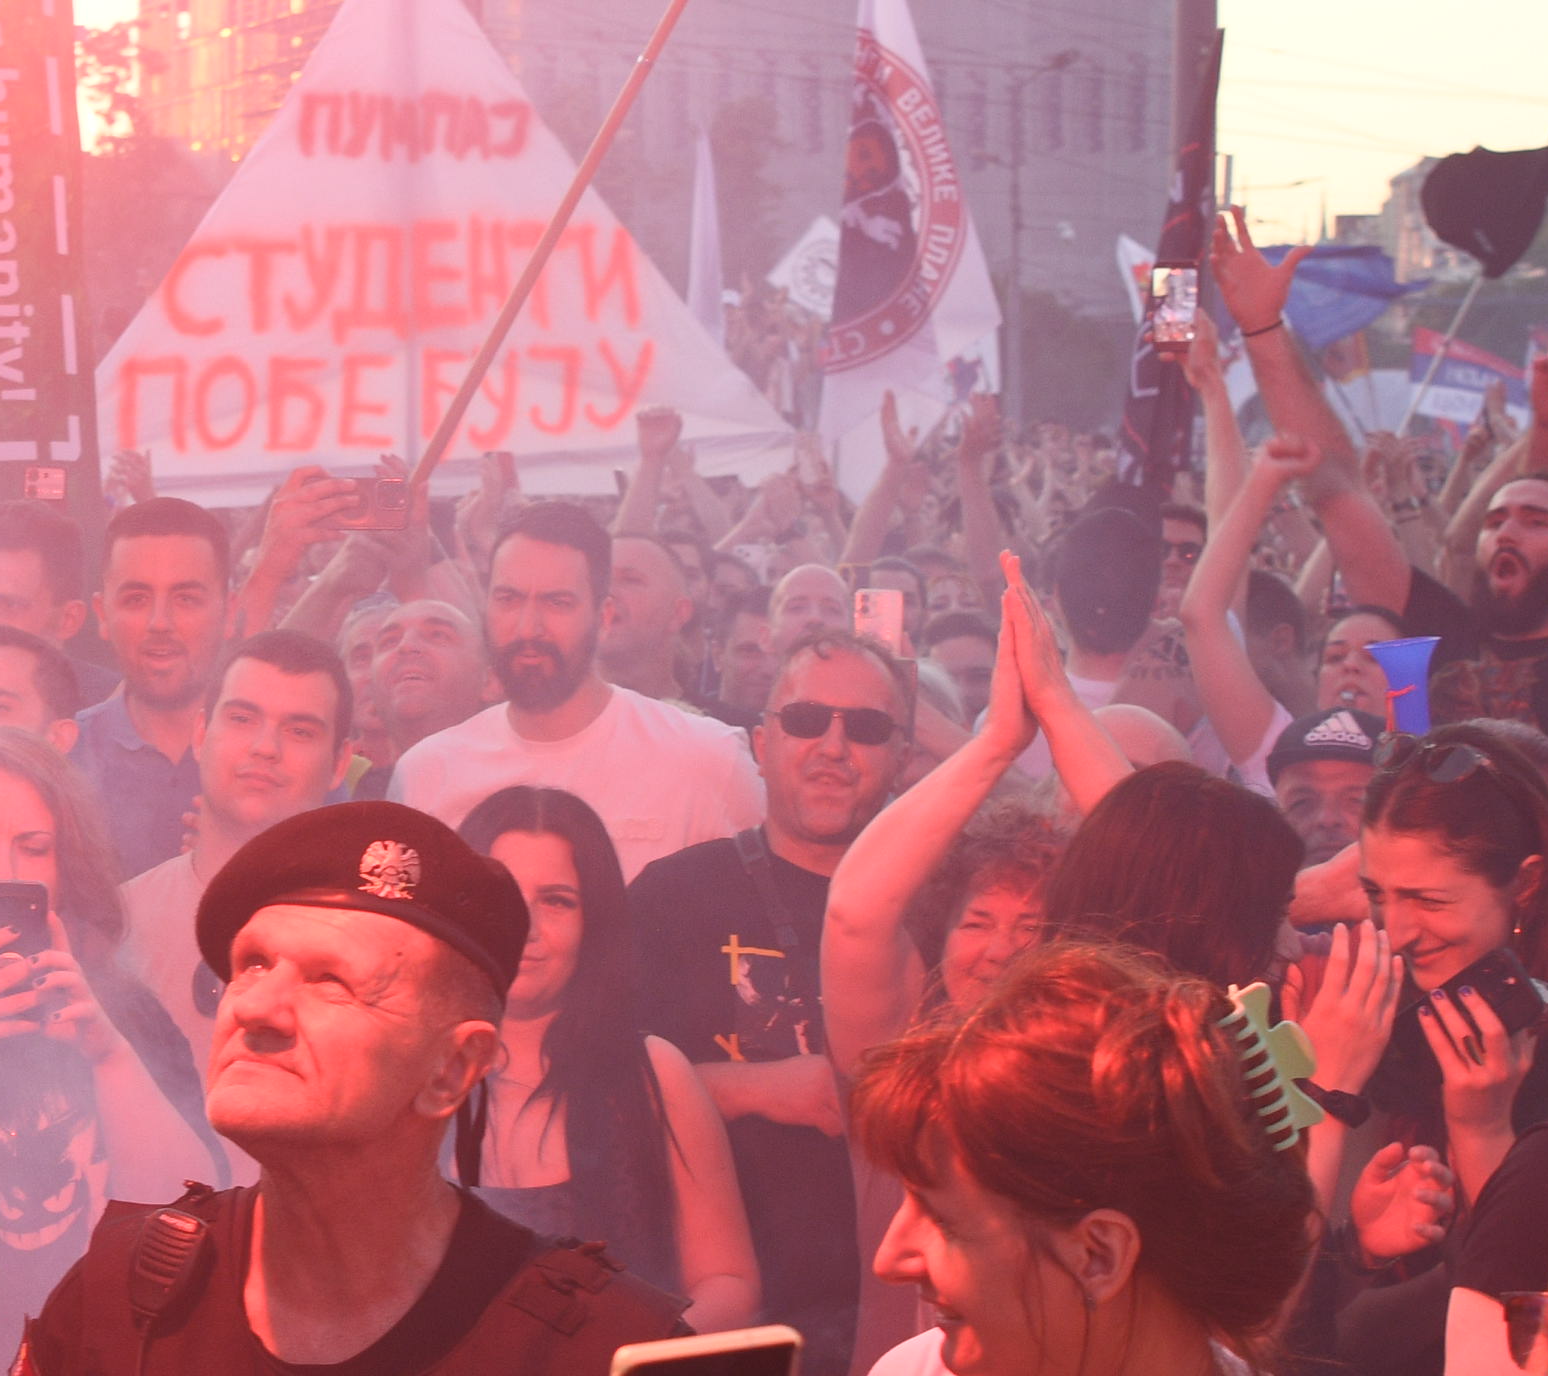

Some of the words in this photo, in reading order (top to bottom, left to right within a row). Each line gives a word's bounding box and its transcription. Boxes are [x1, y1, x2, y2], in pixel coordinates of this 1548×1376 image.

[296, 91, 534, 164] ПУМПАЈ
[895, 85, 959, 205] ВЕЛИКЕ
[161, 212, 644, 346] СТУДЕНТИ
[1304, 728, 1372, 748] adidas
